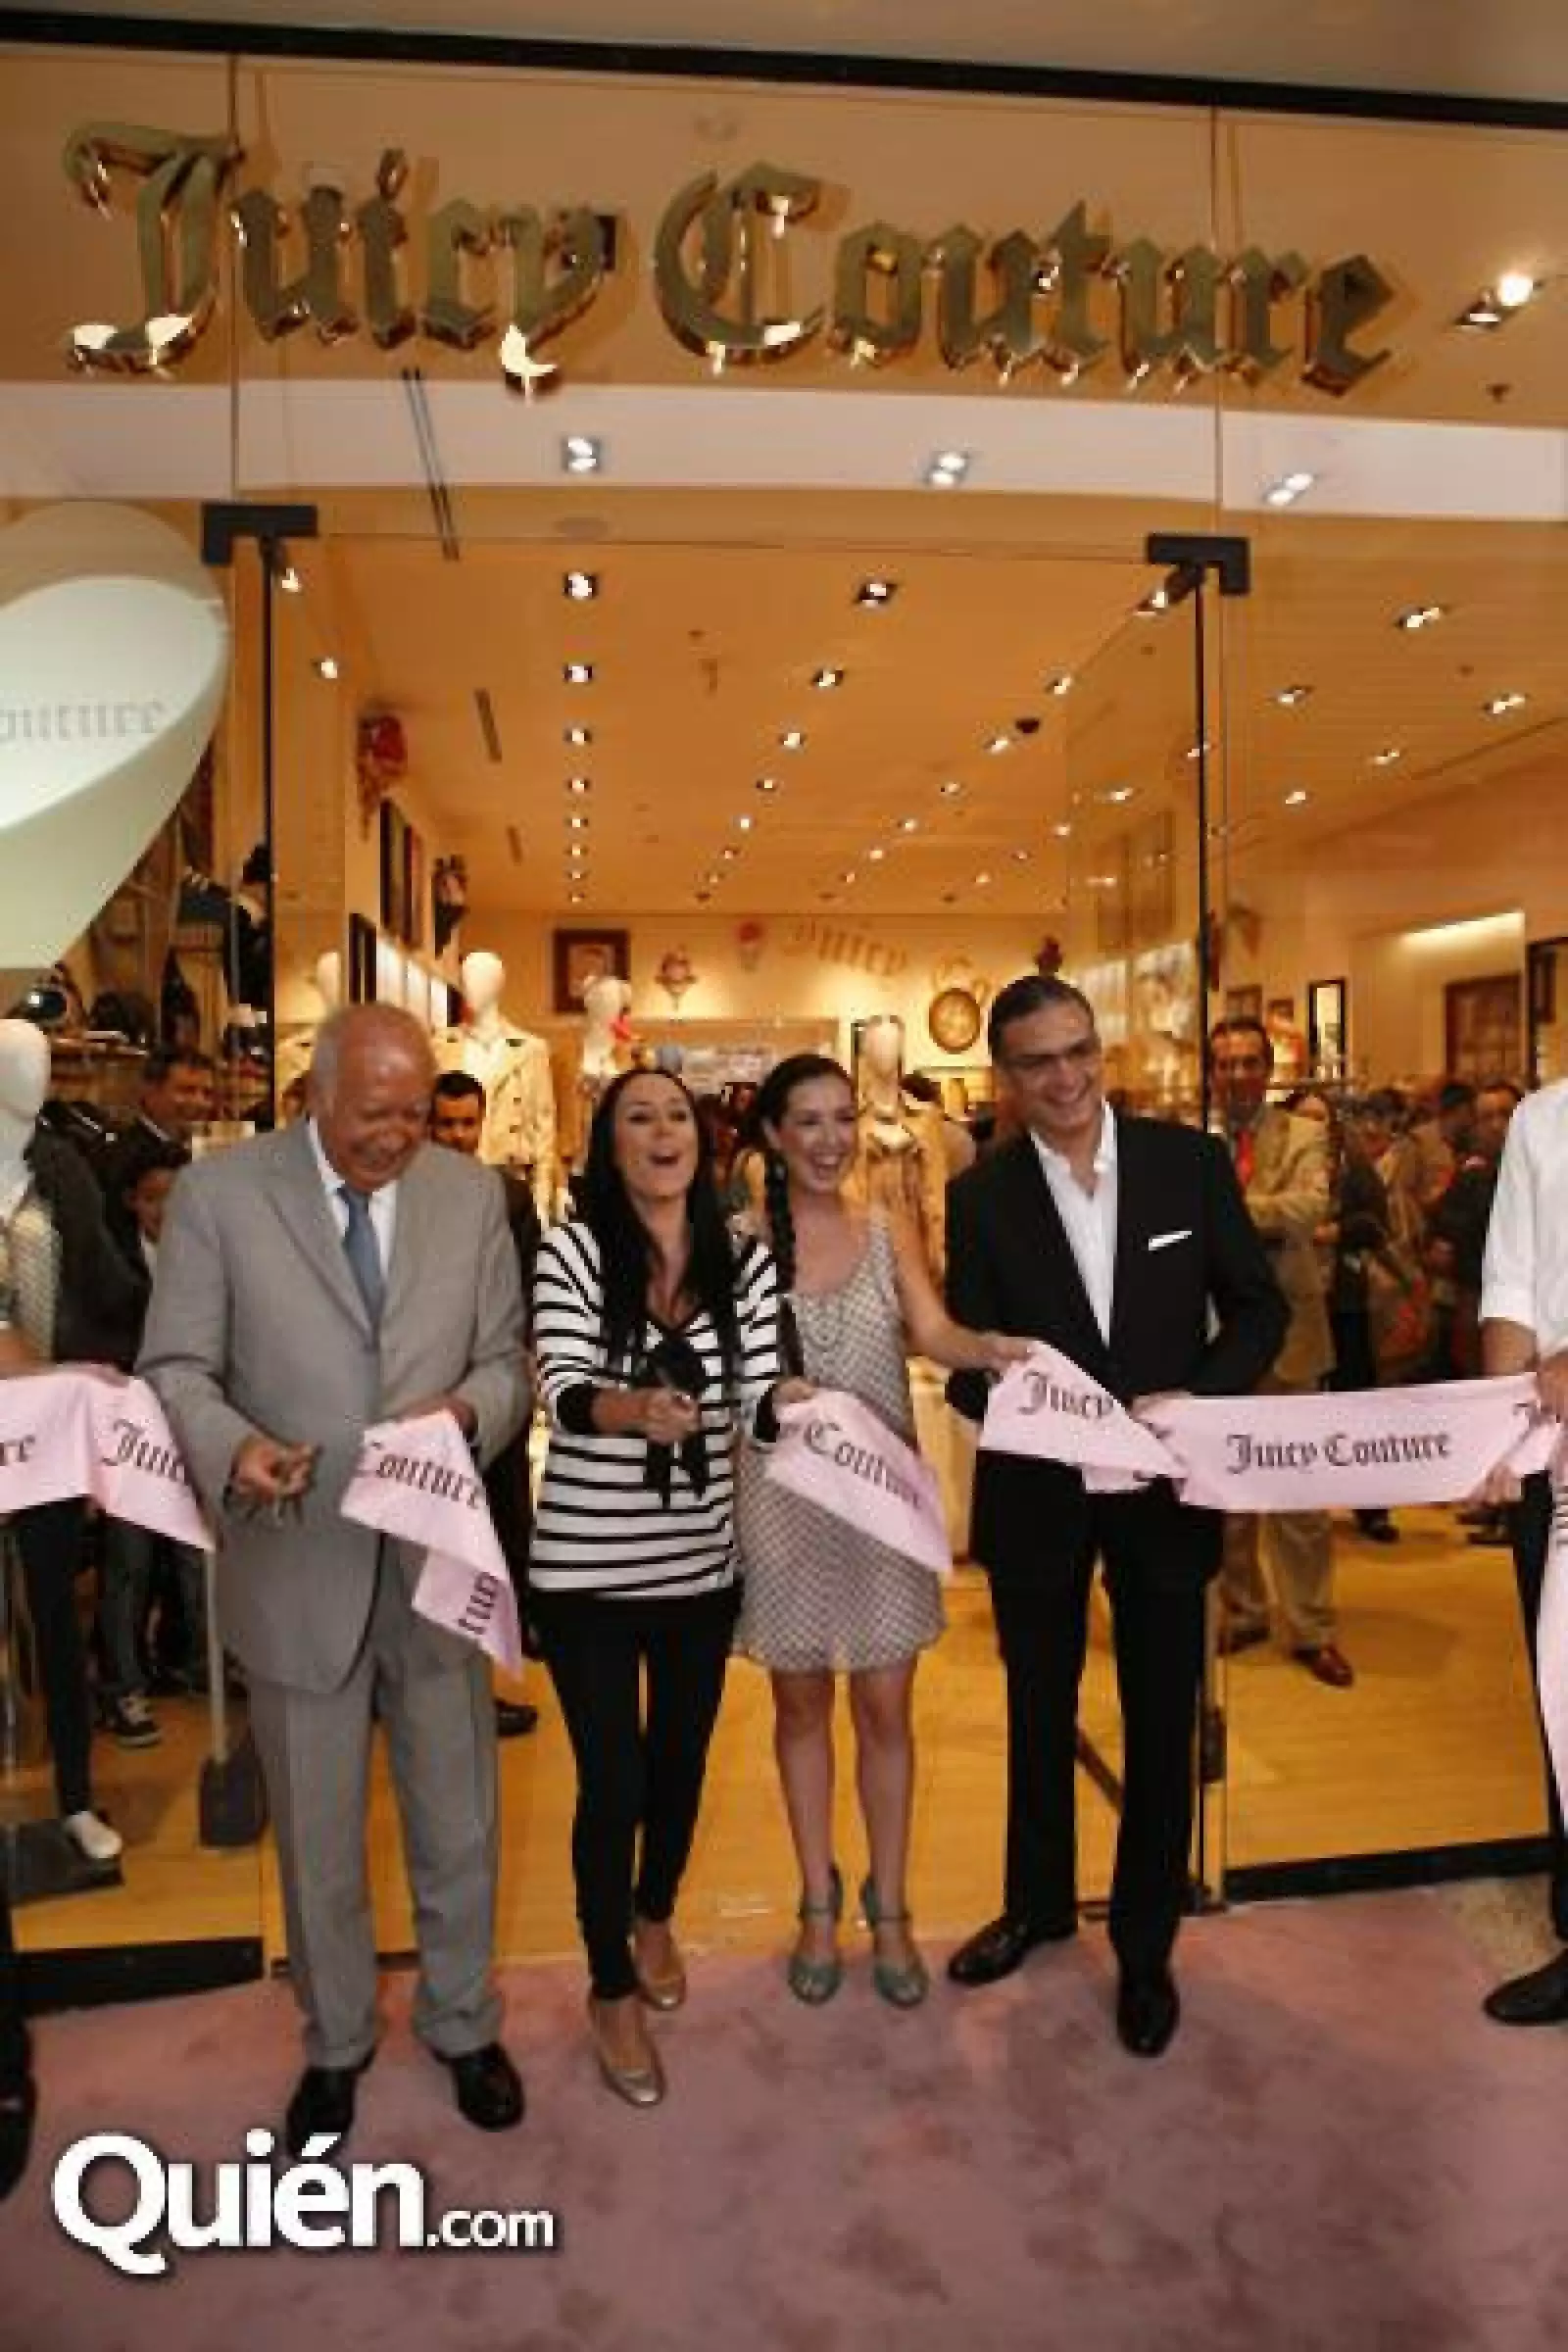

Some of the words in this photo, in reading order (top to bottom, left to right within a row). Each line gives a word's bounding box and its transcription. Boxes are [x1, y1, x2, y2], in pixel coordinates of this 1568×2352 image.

[64, 120, 613, 400] Juicy
[654, 160, 1395, 396] Couture
[1226, 1434, 1319, 1475] Juicy
[1324, 1433, 1448, 1467] Couture
